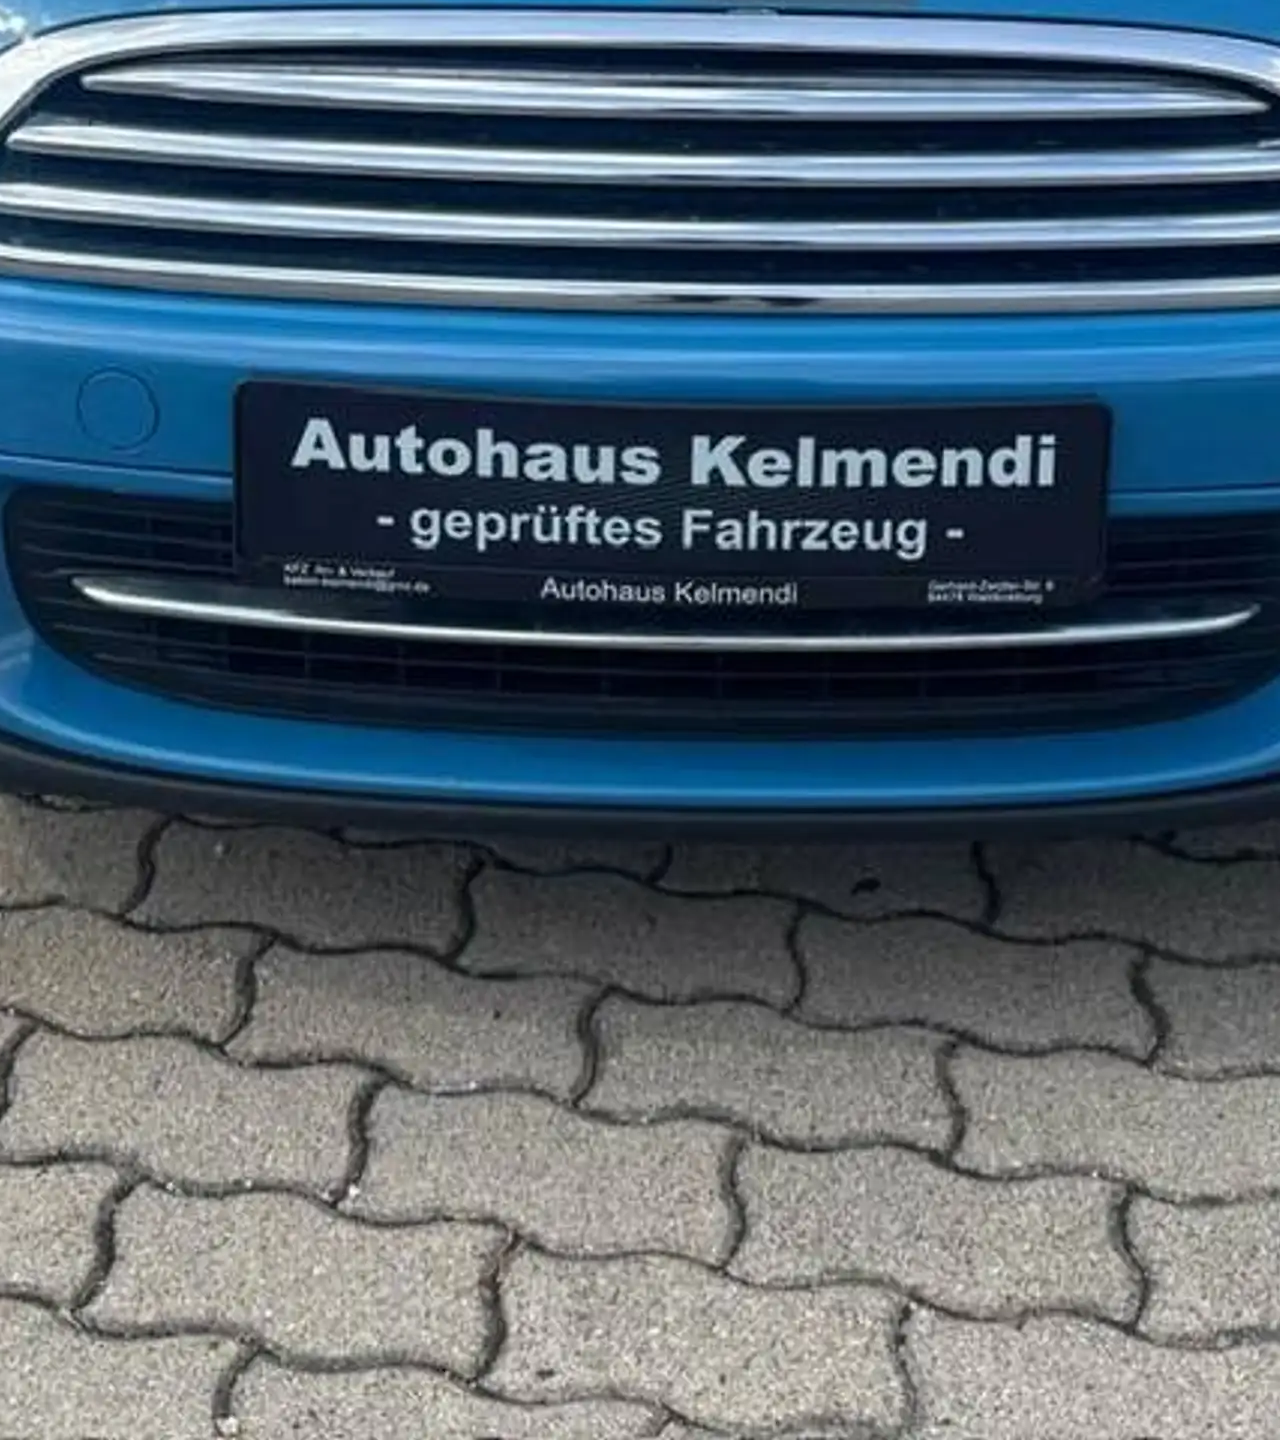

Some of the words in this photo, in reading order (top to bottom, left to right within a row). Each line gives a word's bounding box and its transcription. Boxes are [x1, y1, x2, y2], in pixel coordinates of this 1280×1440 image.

[291, 417, 662, 485] Autohaus
[690, 433, 1057, 488] Kelmendi
[410, 504, 663, 553] geprüftes
[681, 508, 928, 561] Fahrzeug
[540, 576, 666, 603] Autohaus
[674, 580, 799, 605] Kelmendi
